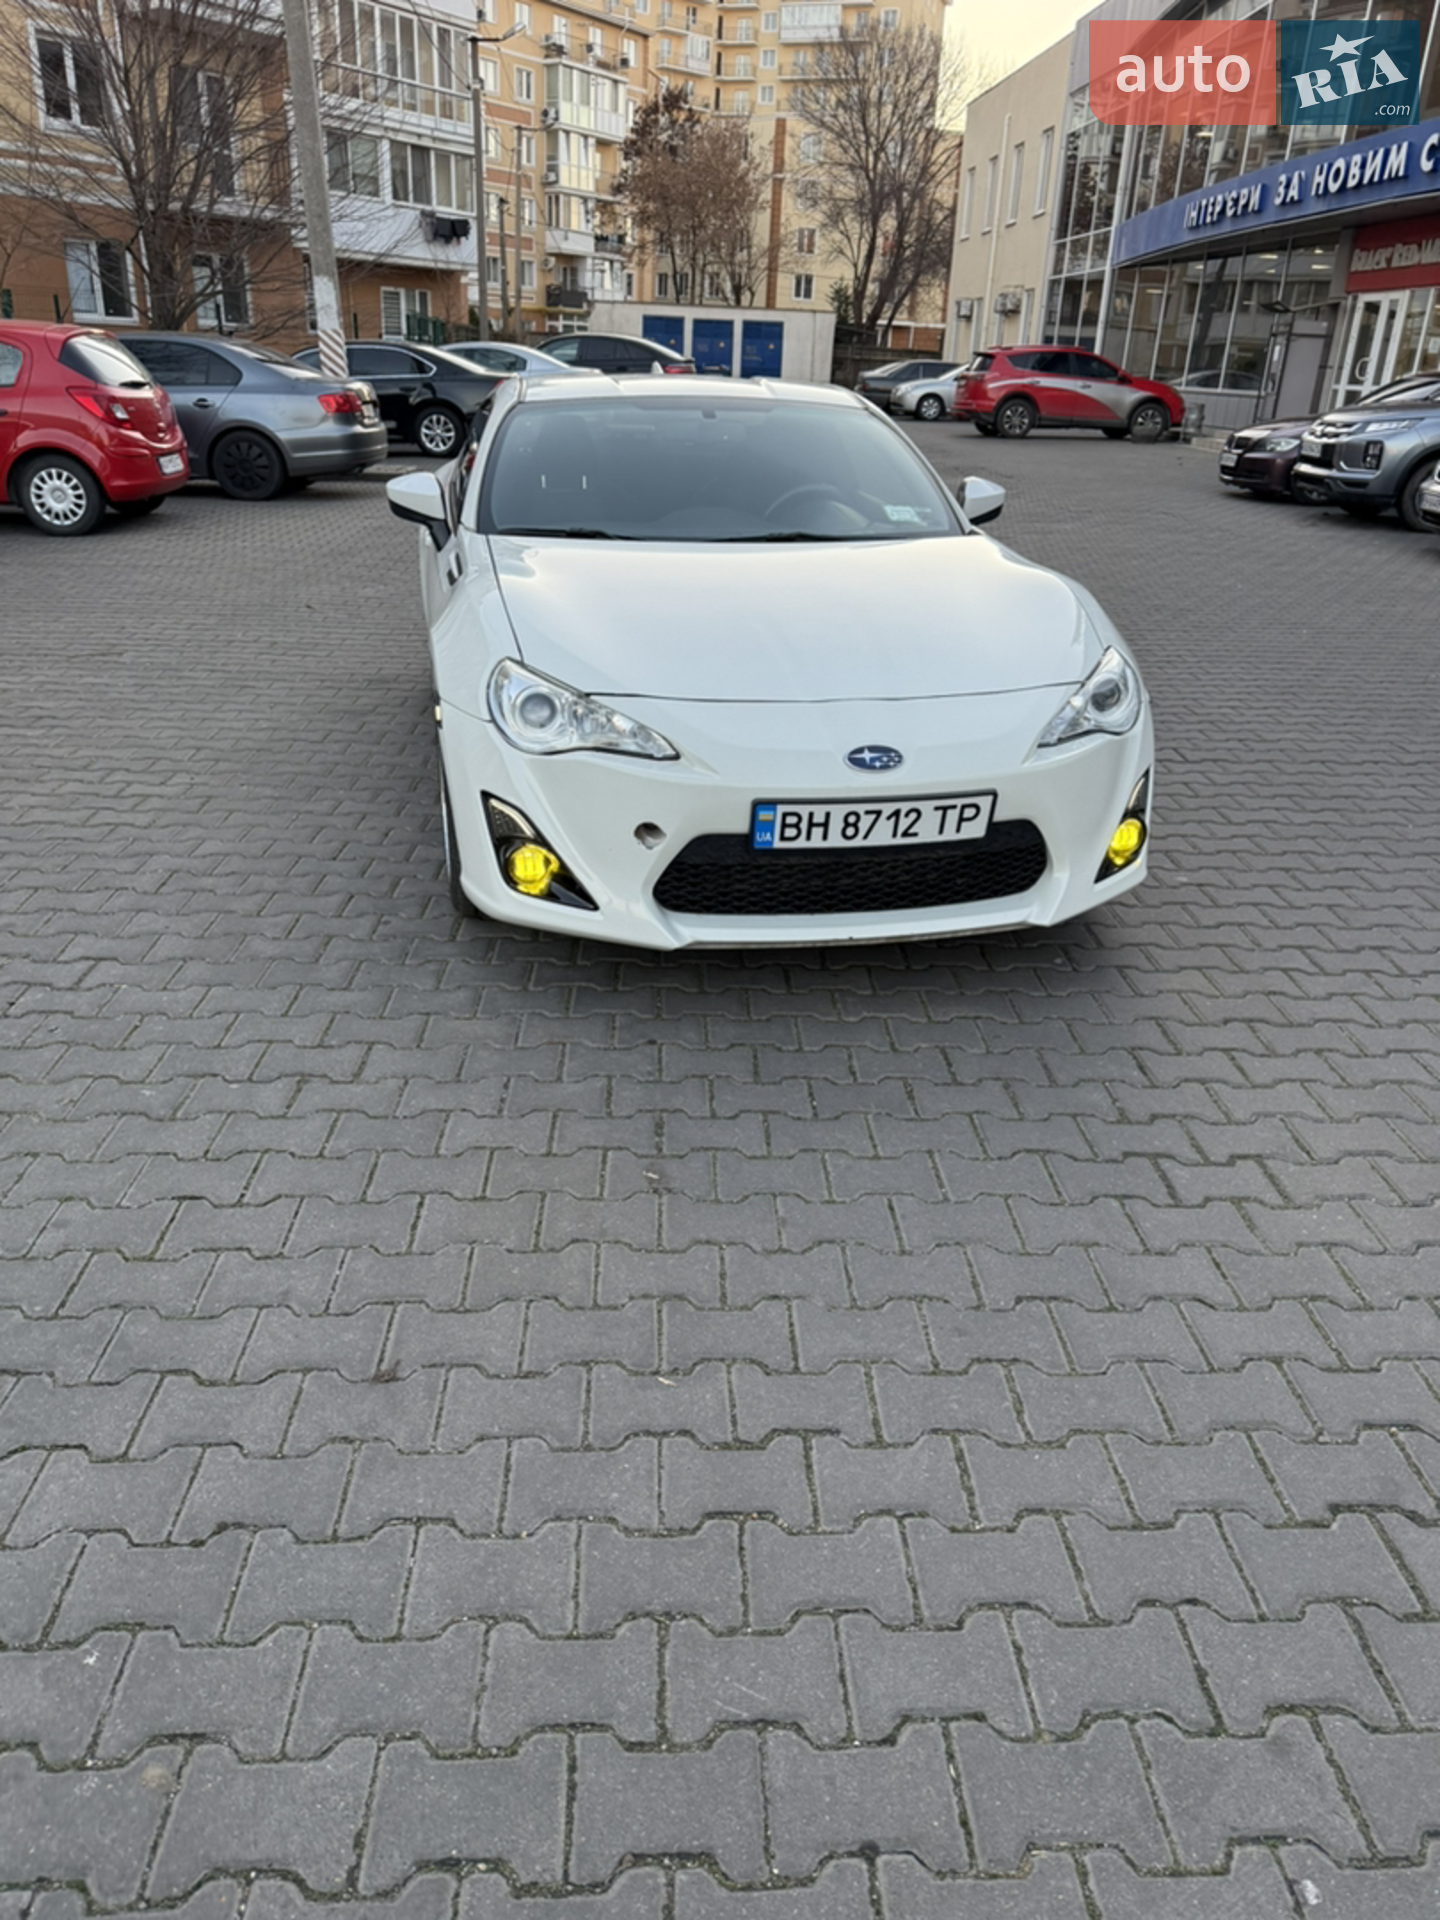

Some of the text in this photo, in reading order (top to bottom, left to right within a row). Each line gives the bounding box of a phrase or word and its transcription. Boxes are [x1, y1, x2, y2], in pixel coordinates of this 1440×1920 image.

[1310, 141, 1410, 197] НОВИМ
[756, 831, 772, 842] UA
[778, 802, 981, 842] BH 8712 TP
